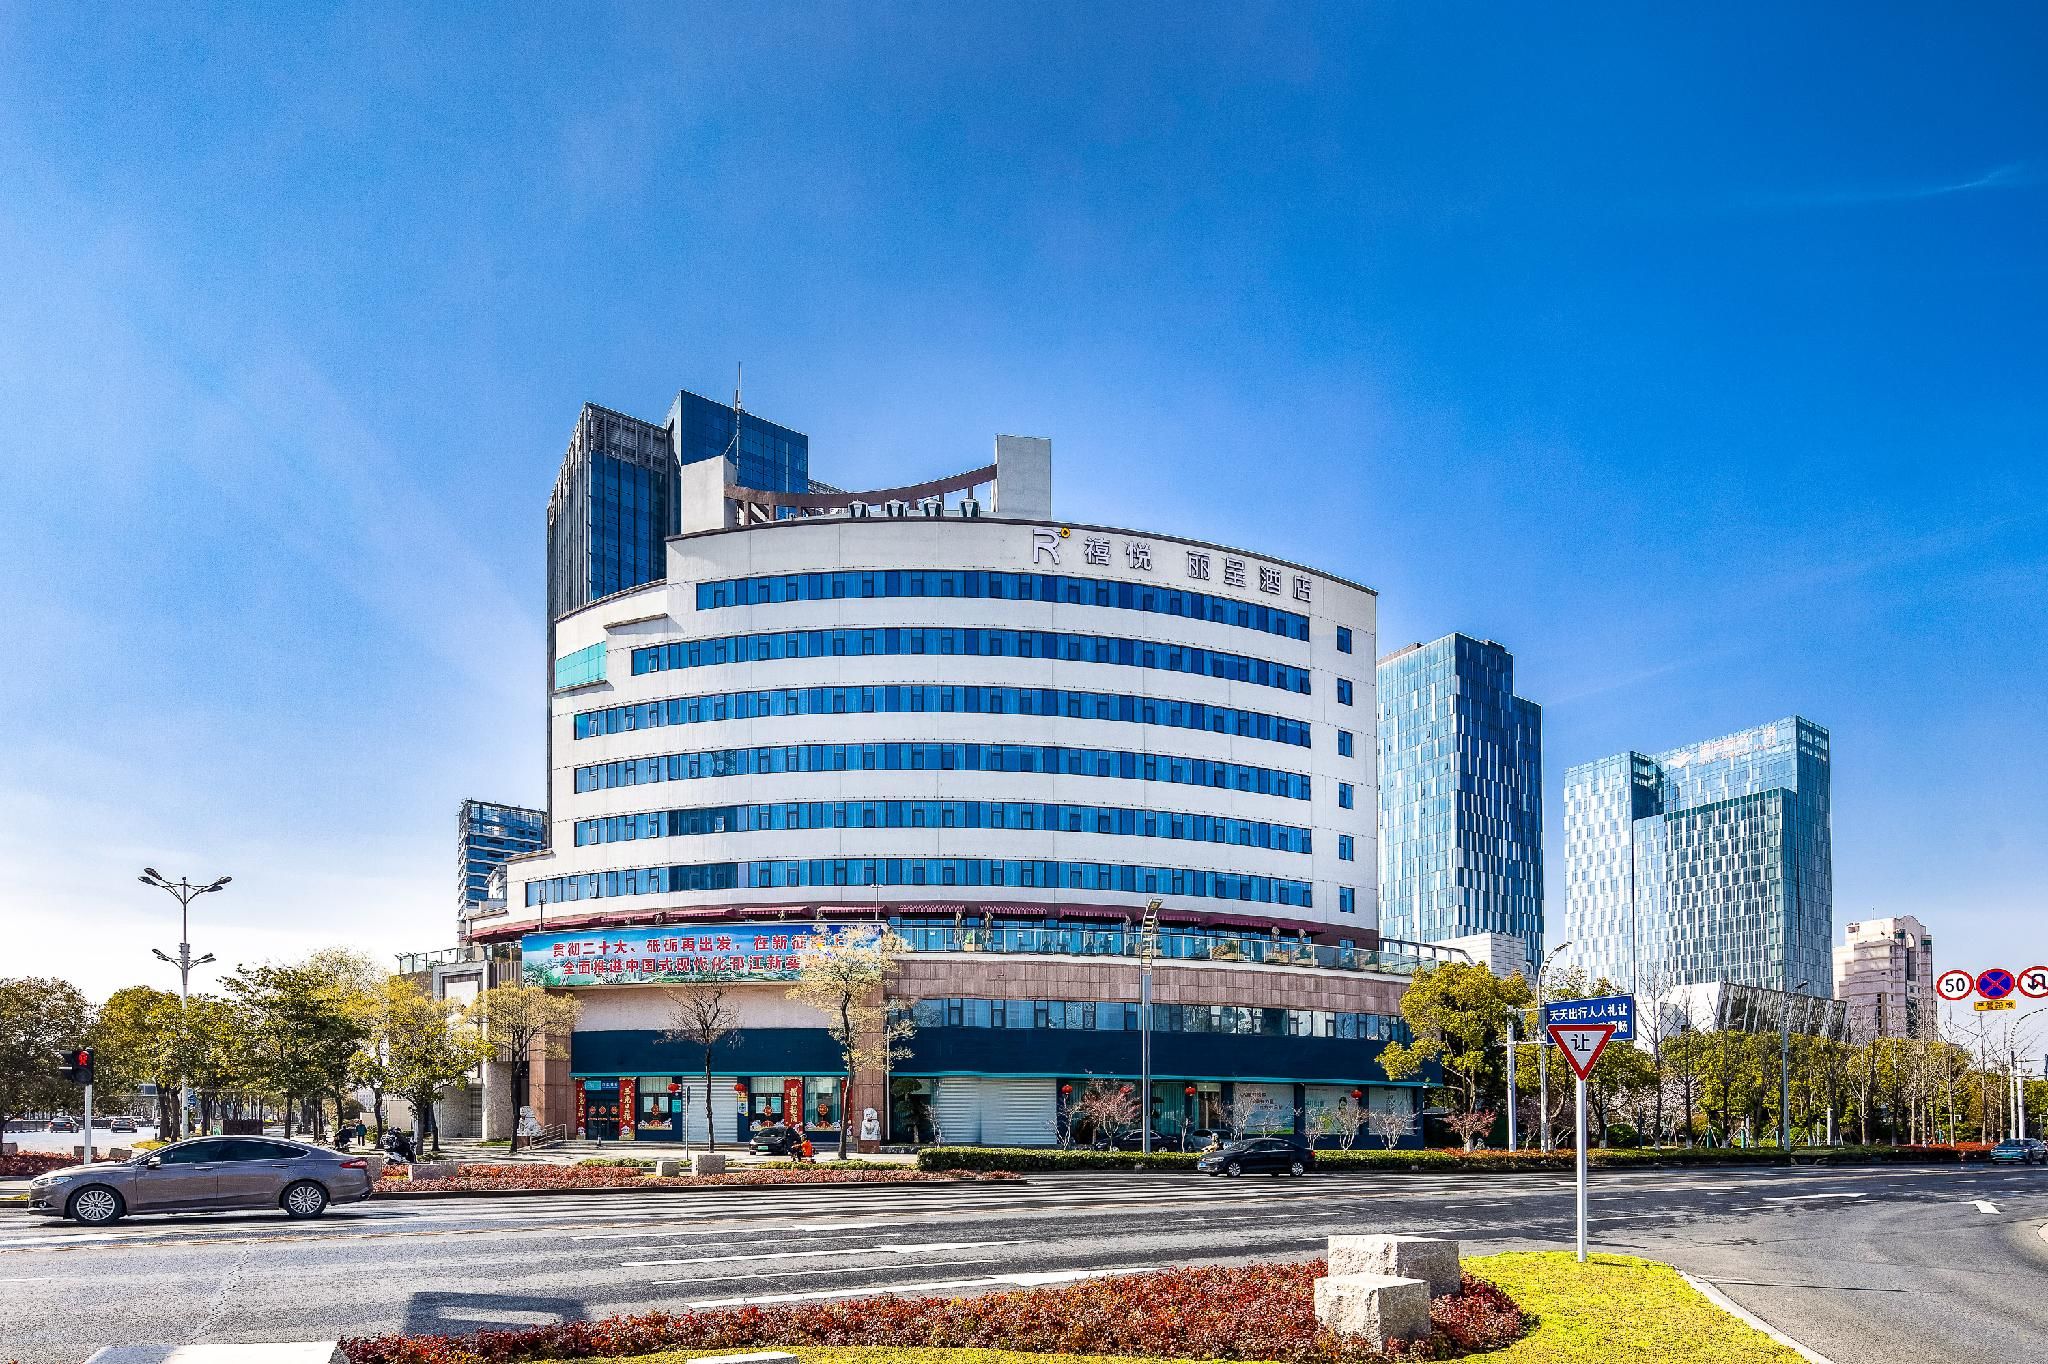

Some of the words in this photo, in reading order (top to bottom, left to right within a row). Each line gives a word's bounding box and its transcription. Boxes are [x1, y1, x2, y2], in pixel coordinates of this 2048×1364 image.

[1084, 536, 1152, 571] 禧悦
[1186, 550, 1312, 603] 丽呈酒店
[1945, 978, 1965, 992] 50
[1550, 1003, 1627, 1021] 天天出行人人礼让
[1571, 1033, 1591, 1051] 让
